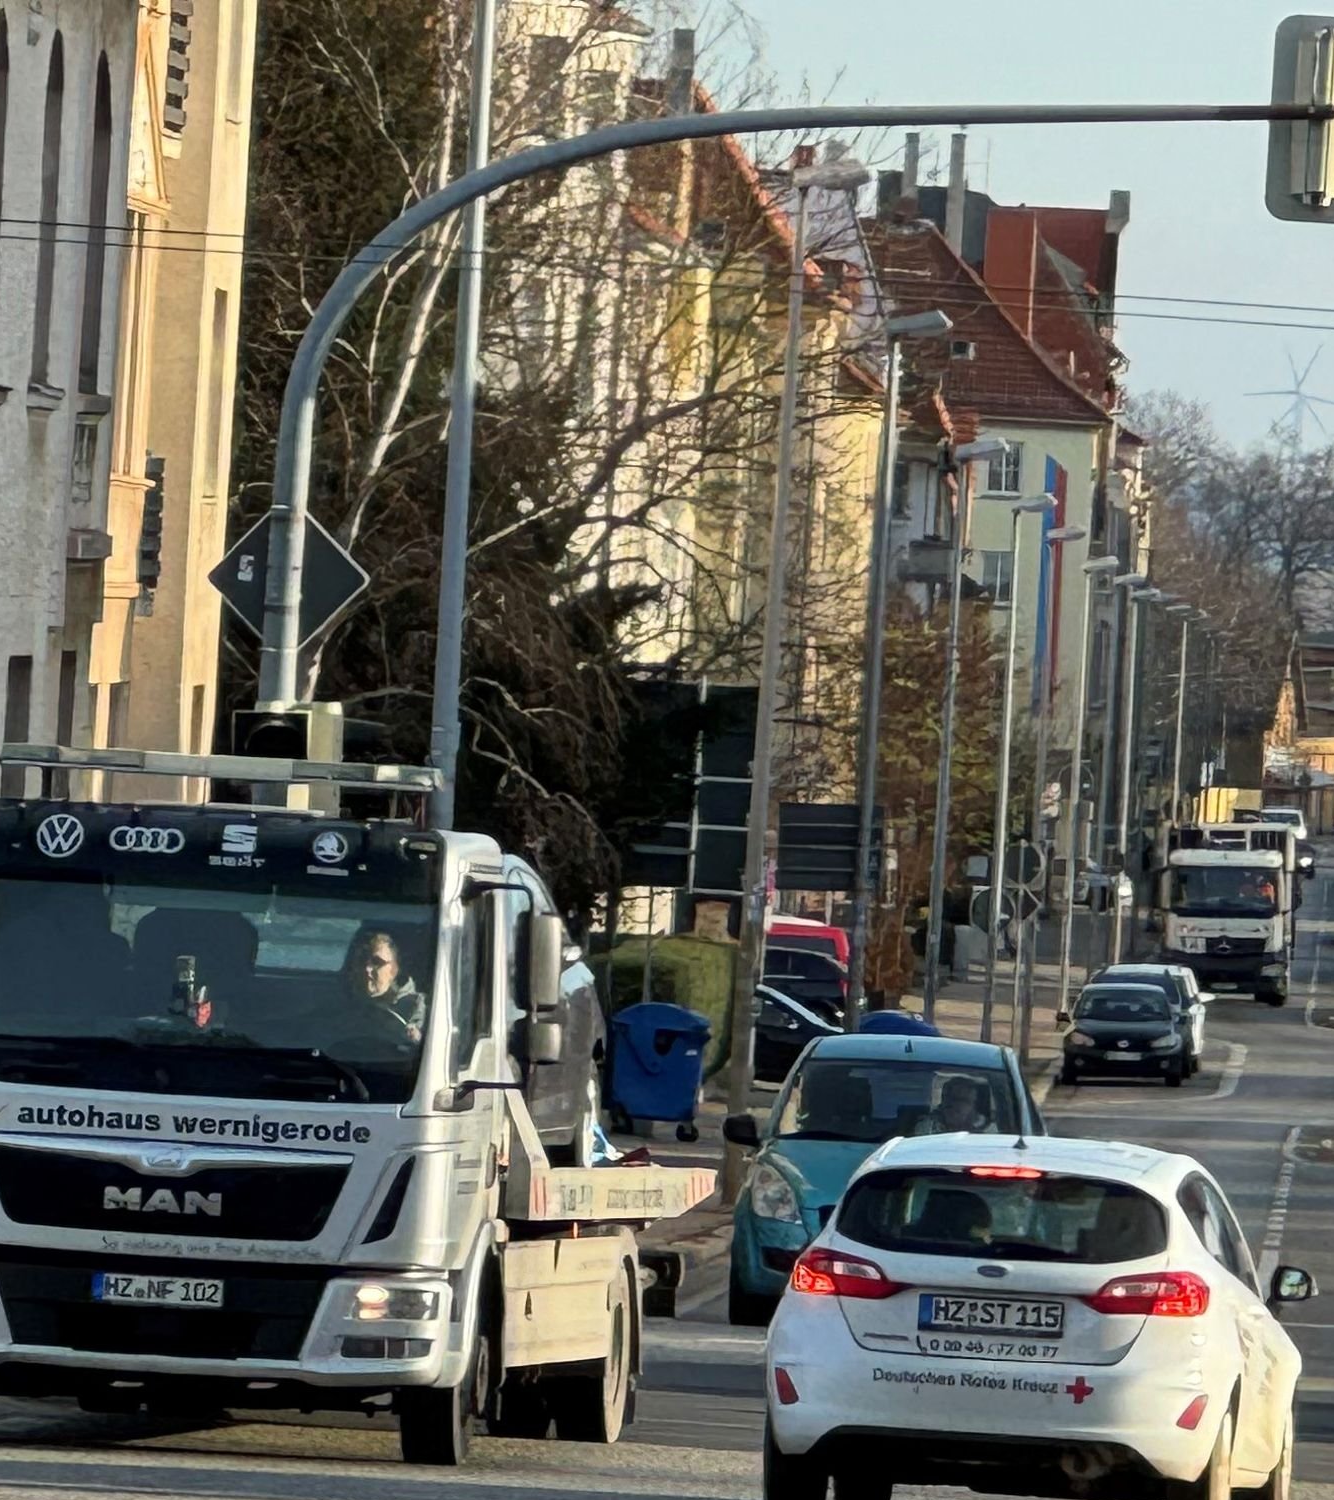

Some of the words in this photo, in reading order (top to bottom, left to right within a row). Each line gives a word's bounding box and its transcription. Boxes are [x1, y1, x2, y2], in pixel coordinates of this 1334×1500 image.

[17, 1105, 161, 1131] autohaus
[172, 1113, 371, 1143] wernigerode
[103, 1186, 223, 1216] MAN
[180, 1283, 220, 1302] 102
[933, 1299, 964, 1323] HZ
[980, 1303, 1011, 1325] ST
[1016, 1306, 1061, 1328] 115
